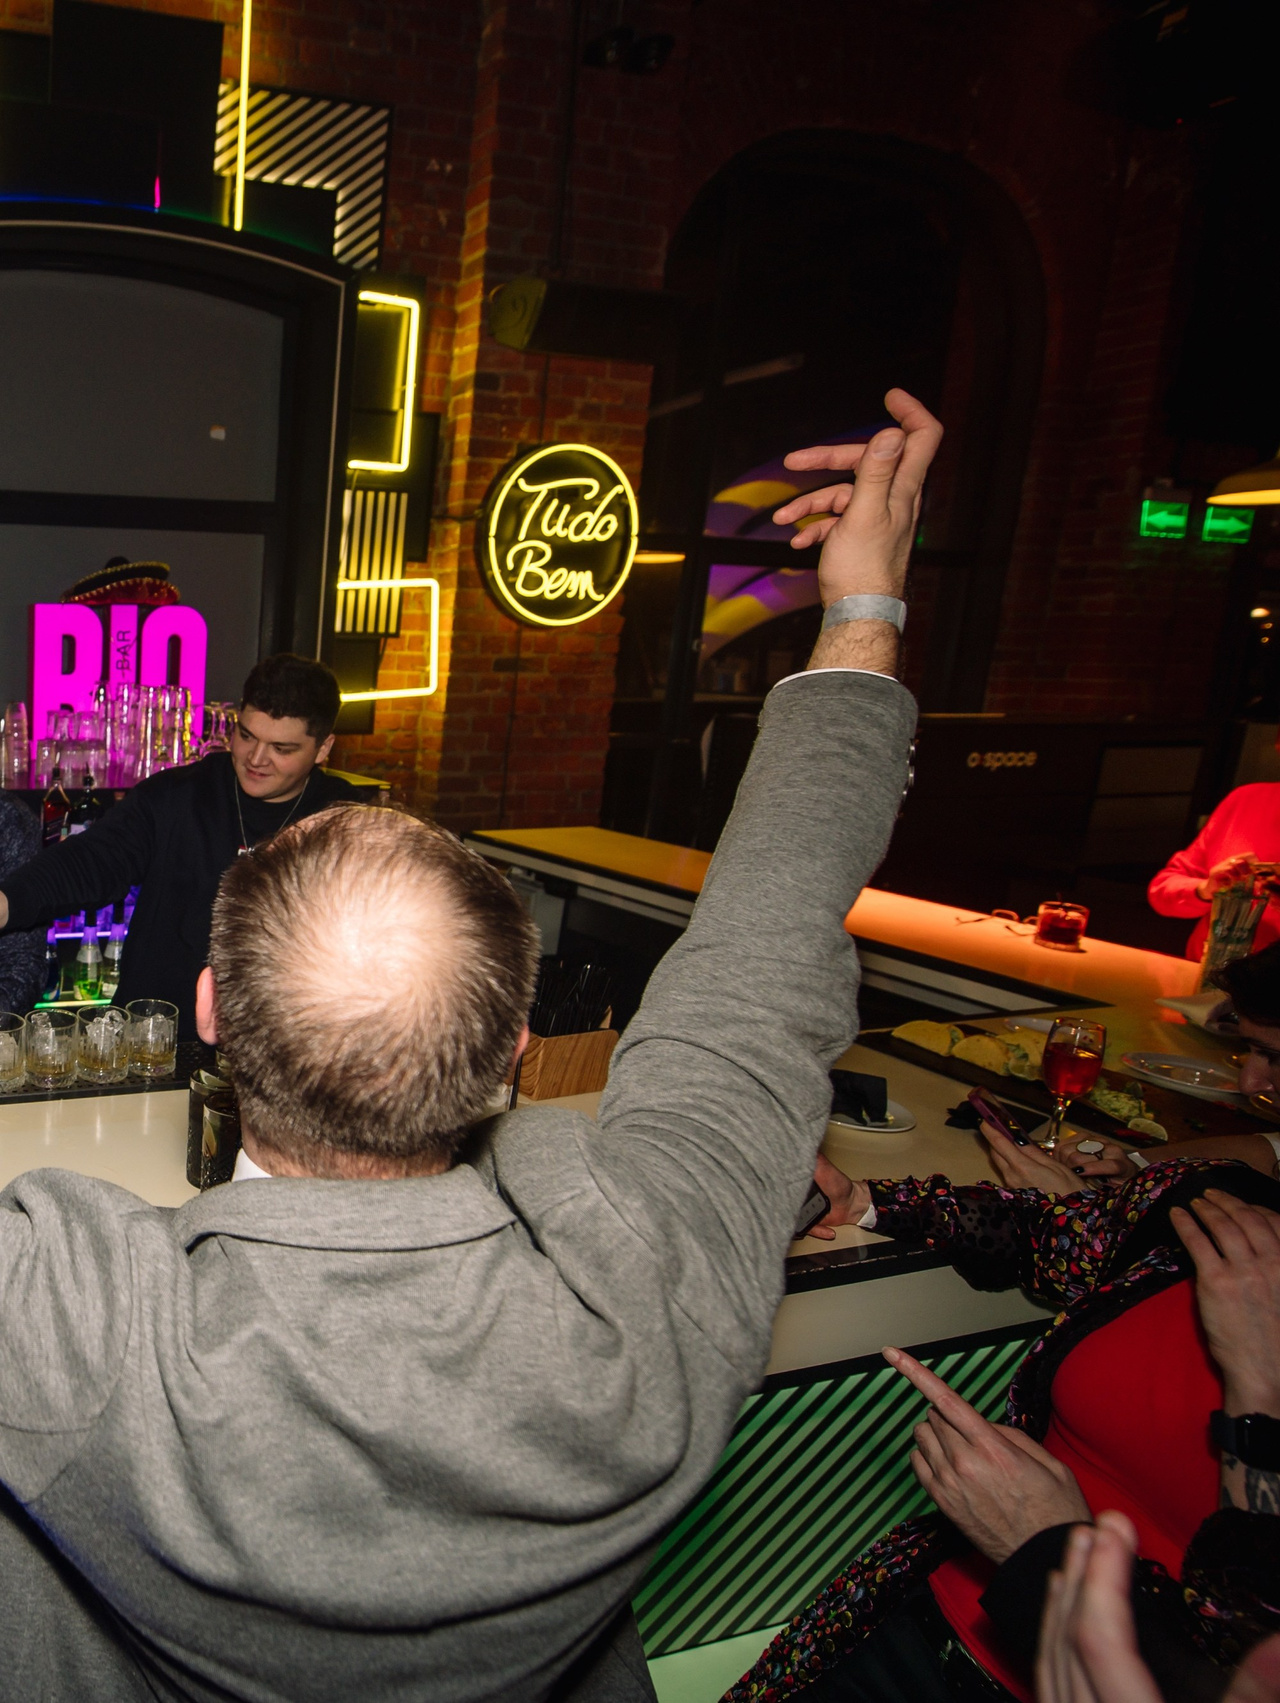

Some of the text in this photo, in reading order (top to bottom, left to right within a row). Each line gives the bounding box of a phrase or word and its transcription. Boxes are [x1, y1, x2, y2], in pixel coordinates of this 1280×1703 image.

[517, 477, 624, 542] Tudo
[506, 540, 605, 602] Bem
[30, 603, 208, 785] RIO
